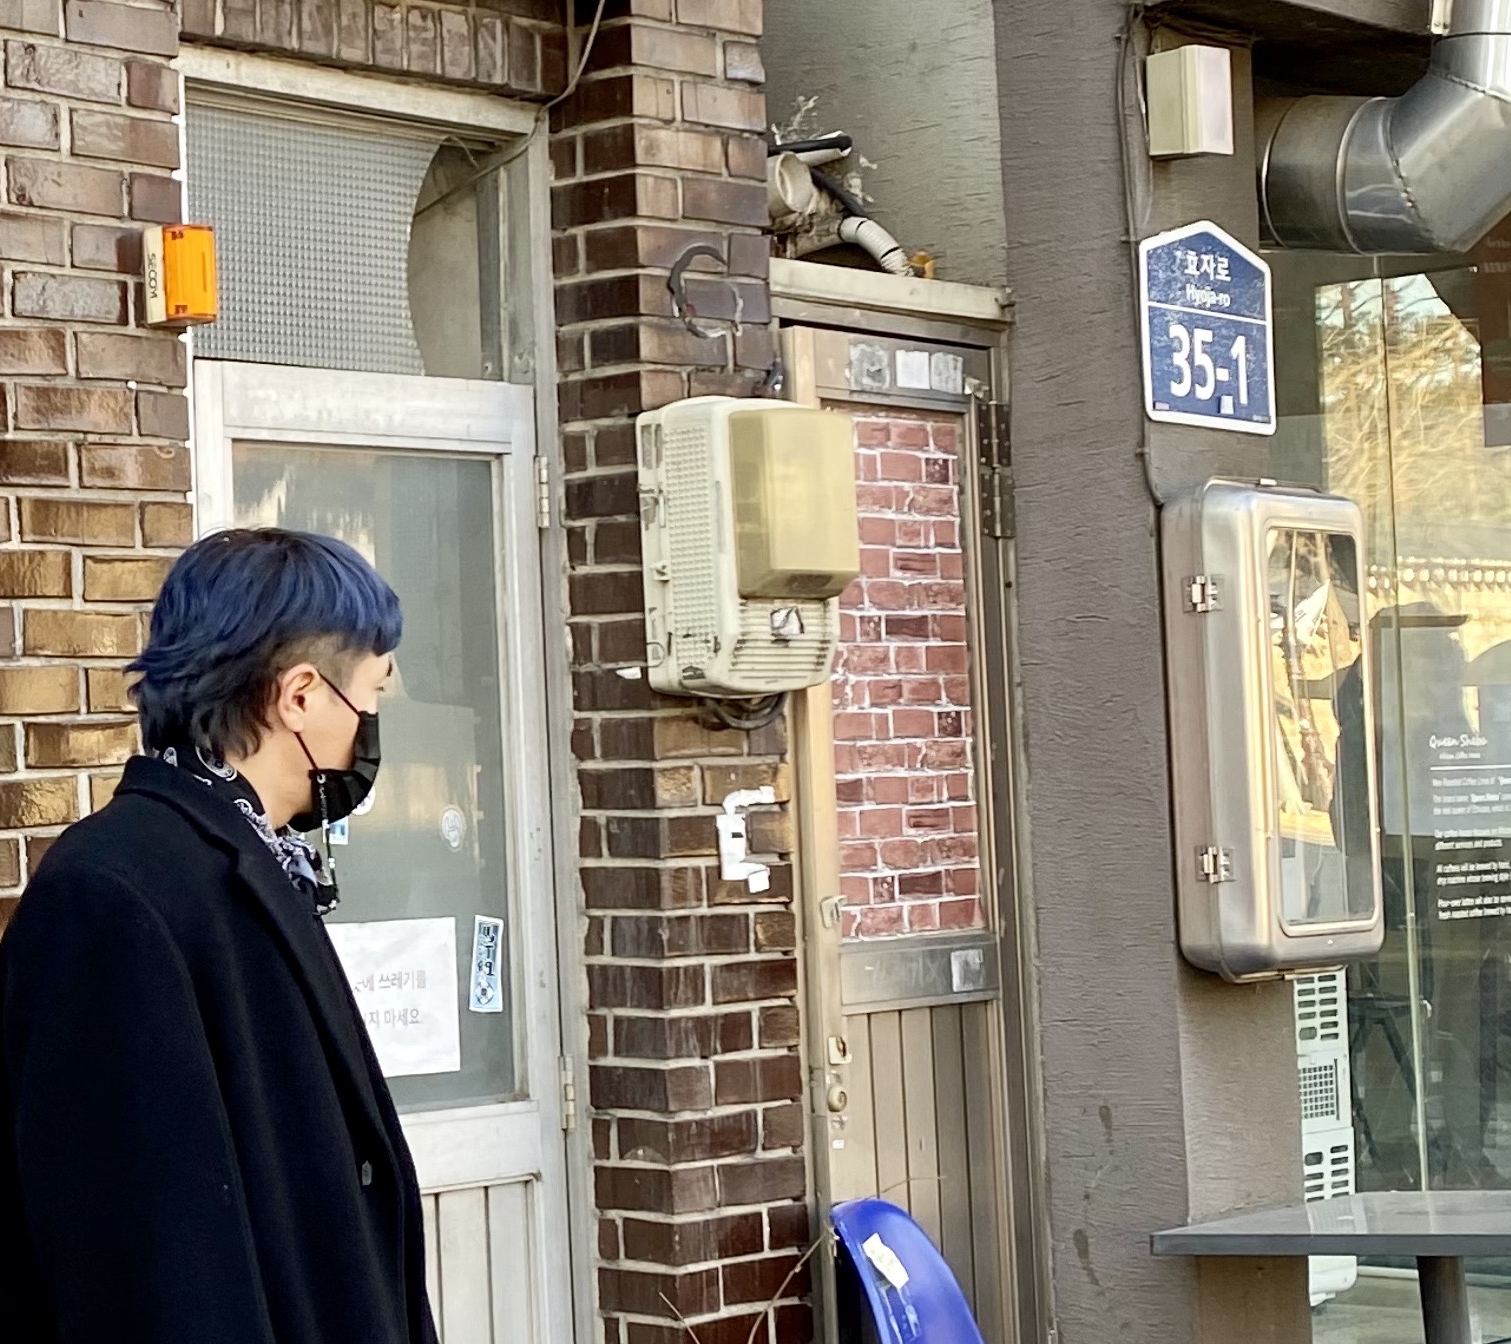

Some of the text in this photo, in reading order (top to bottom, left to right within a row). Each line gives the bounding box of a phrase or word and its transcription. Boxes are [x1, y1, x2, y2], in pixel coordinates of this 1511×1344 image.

[147, 252, 158, 299] SECOM
[1184, 249, 1231, 282] 효자로
[1185, 283, 1231, 308] Hyoja-ro
[1168, 323, 1249, 406] 35-1
[379, 969, 427, 991] 쓰레기를
